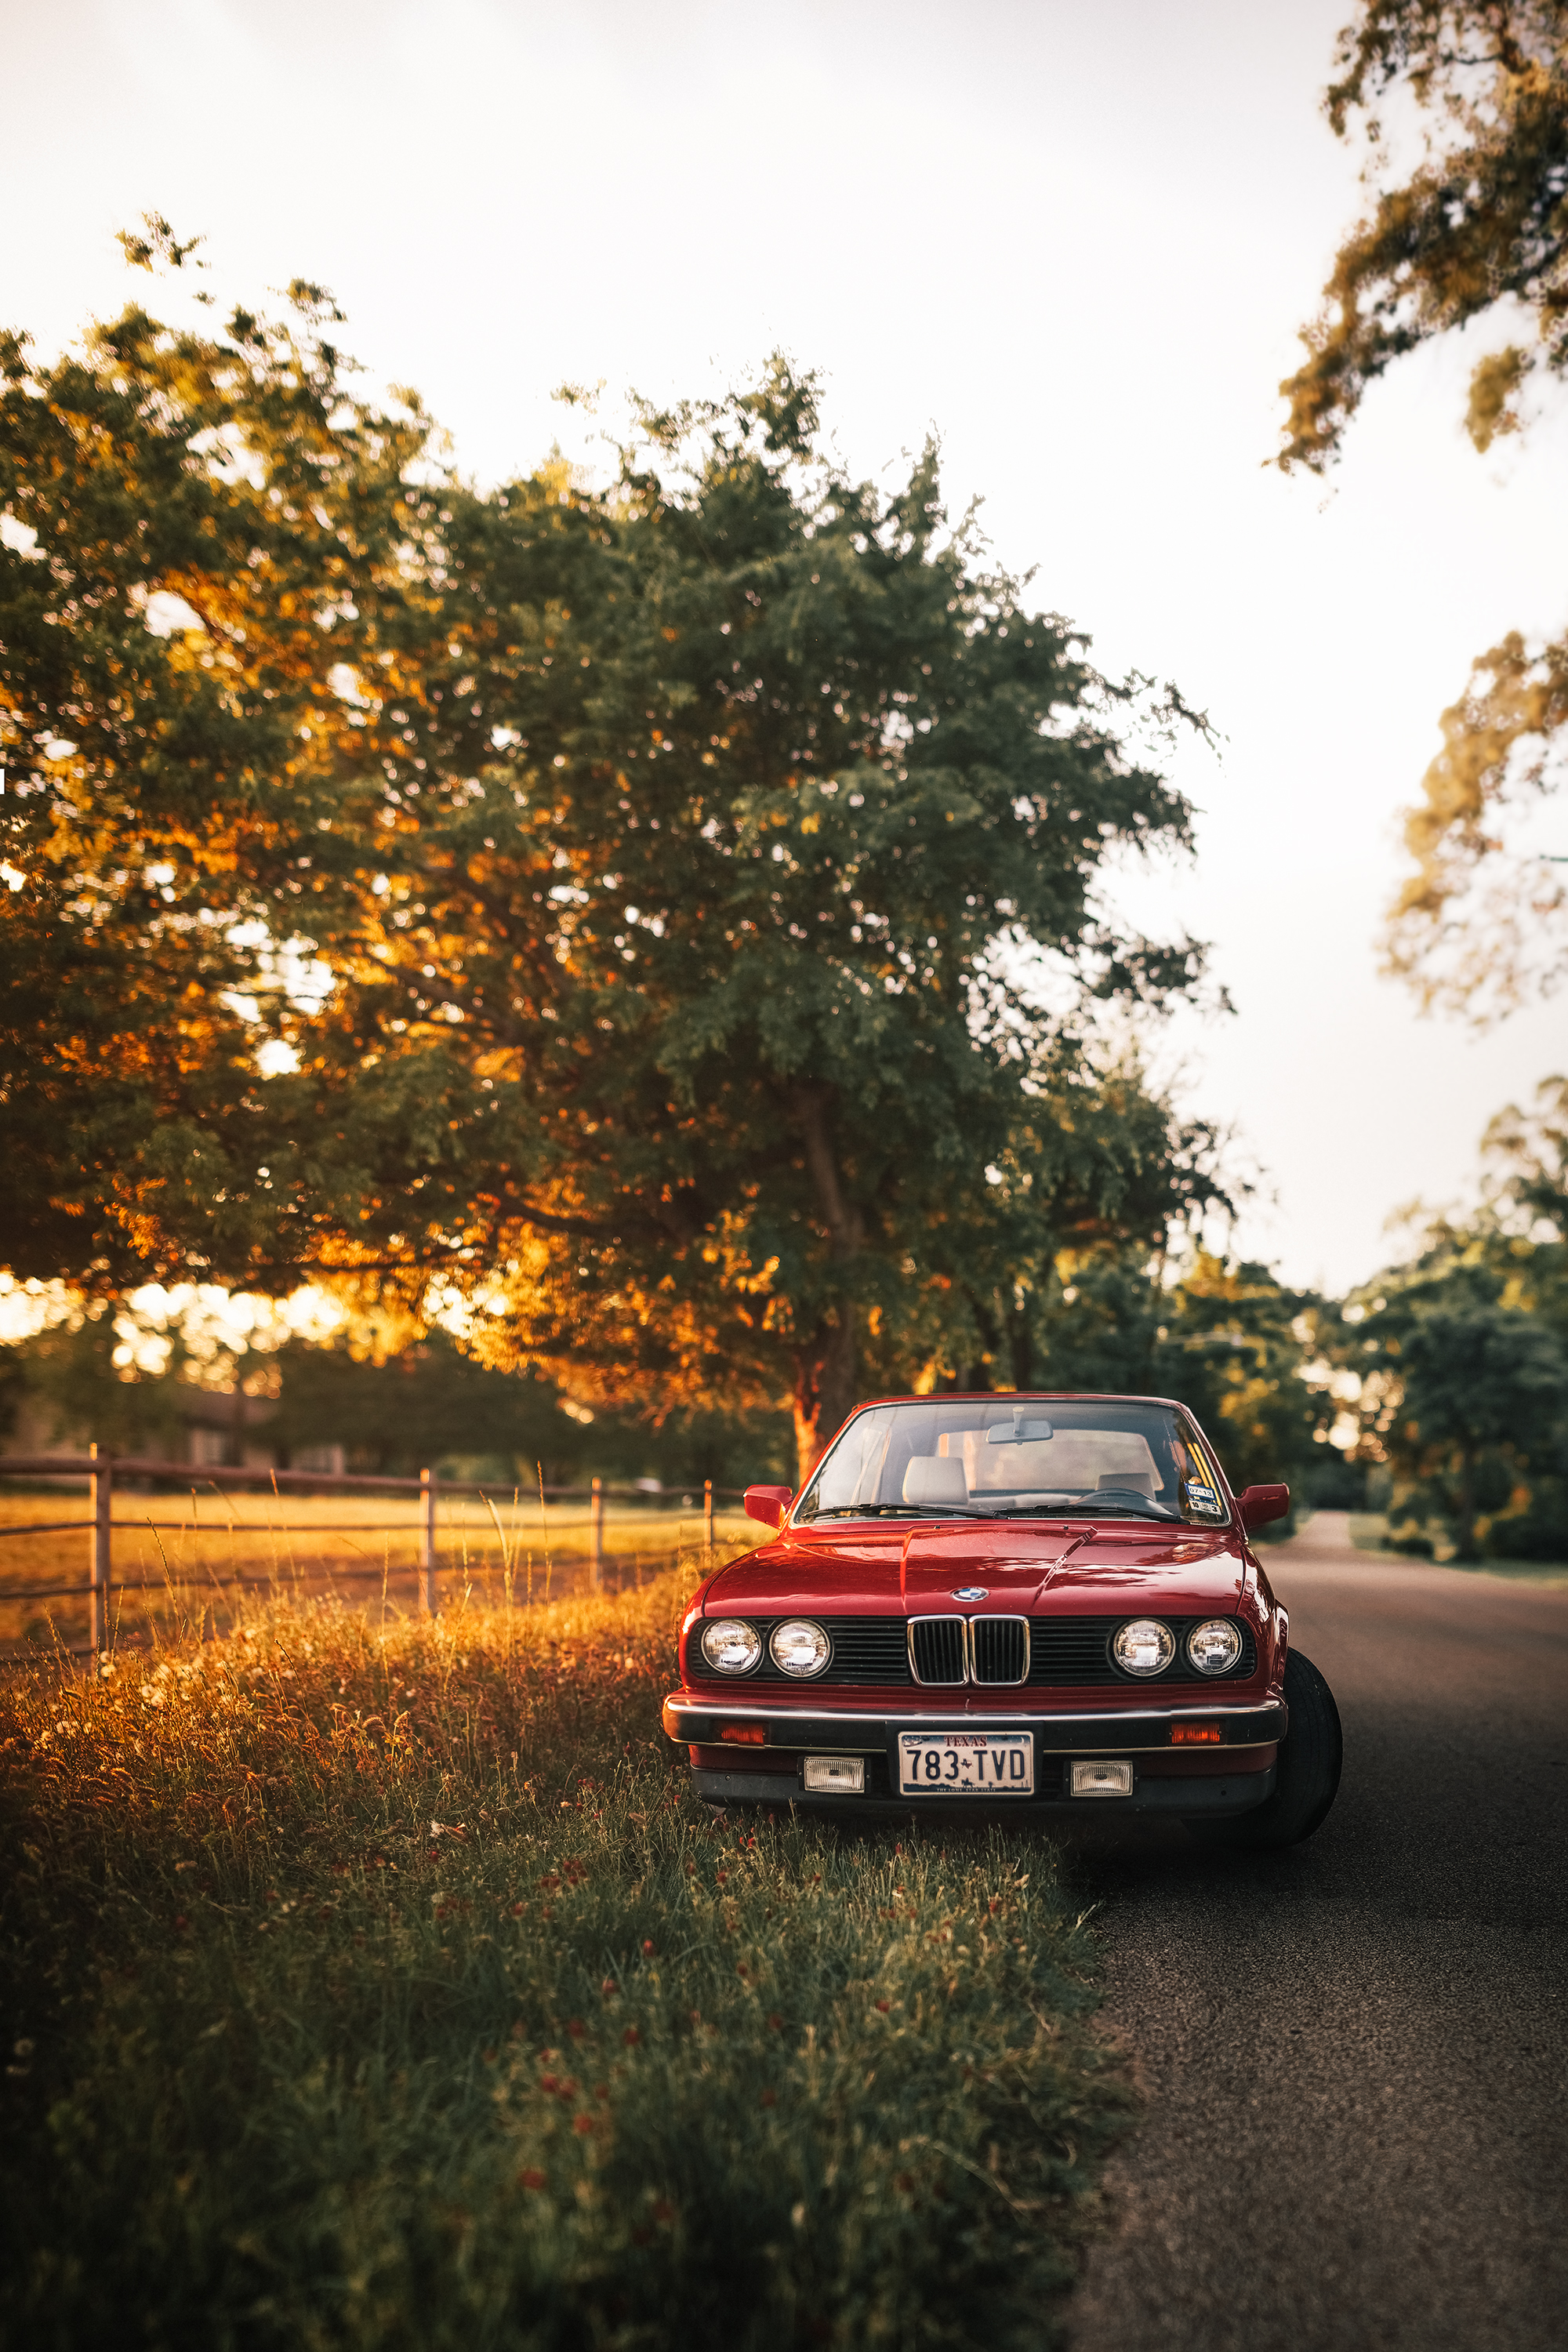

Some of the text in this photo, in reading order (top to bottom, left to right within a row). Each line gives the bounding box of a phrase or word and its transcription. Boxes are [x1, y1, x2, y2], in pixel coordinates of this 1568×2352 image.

[944, 1736, 987, 1747] TEXAS
[906, 1750, 1025, 1780] 783 TVD
